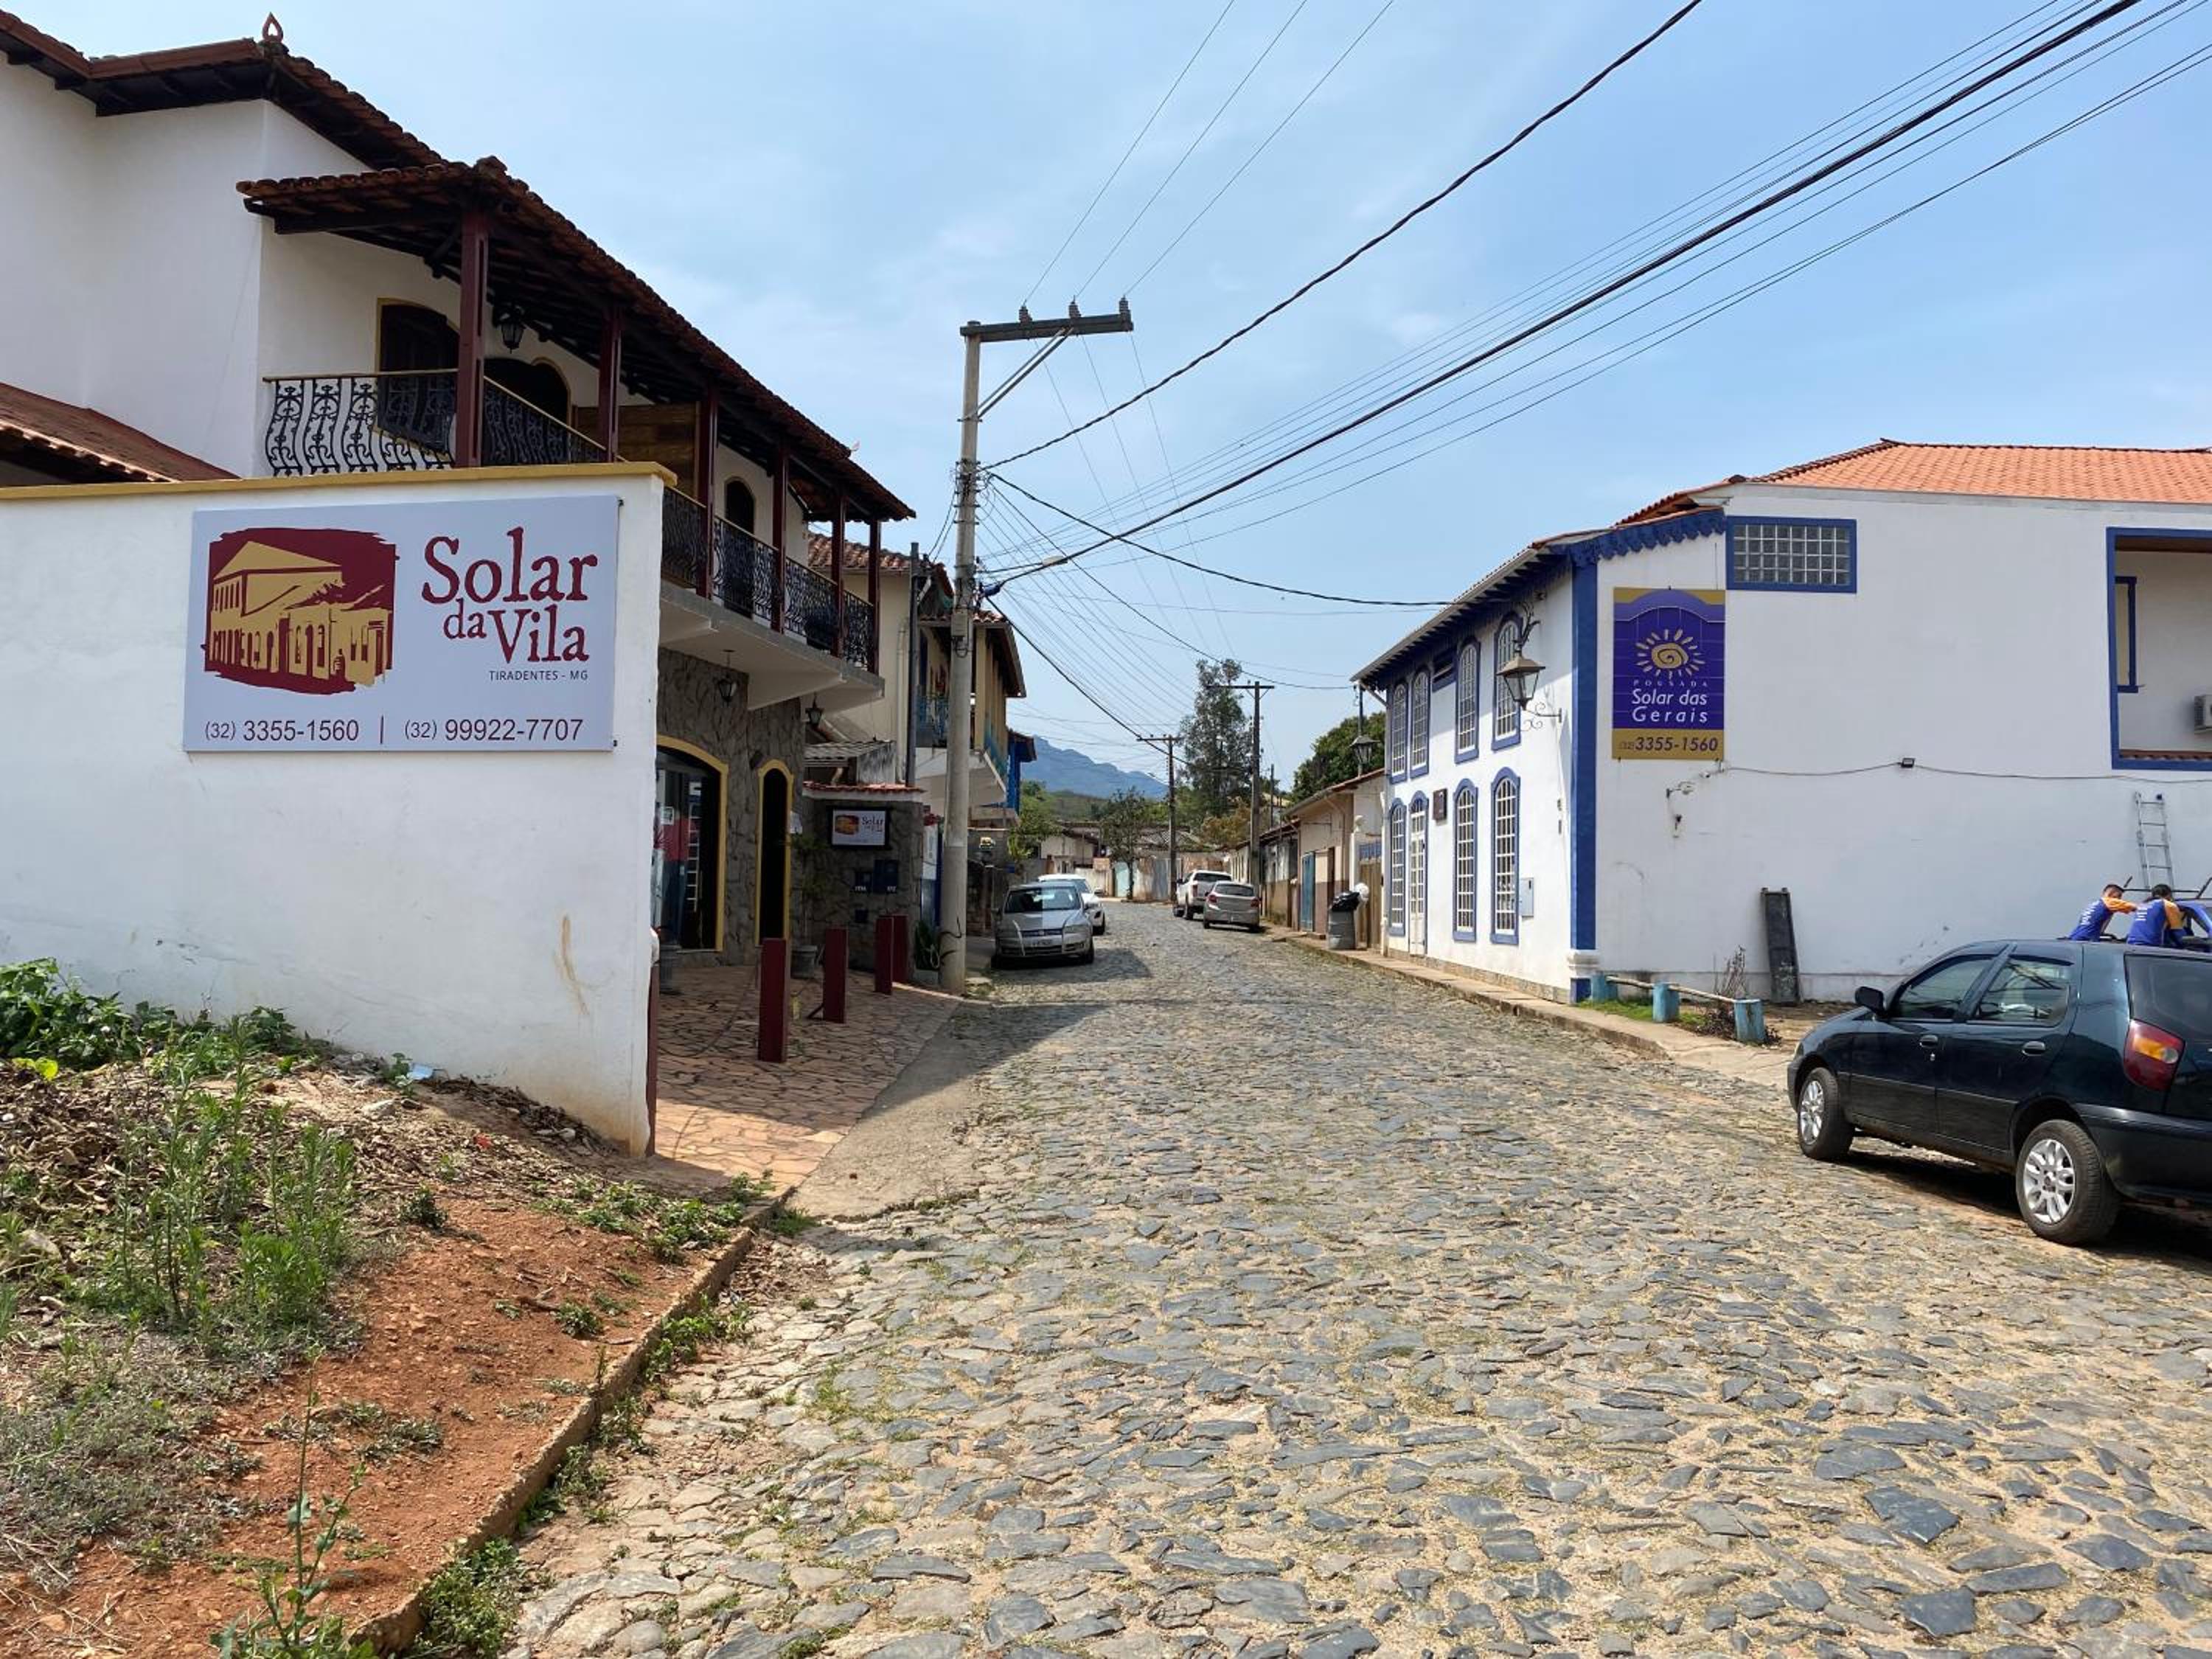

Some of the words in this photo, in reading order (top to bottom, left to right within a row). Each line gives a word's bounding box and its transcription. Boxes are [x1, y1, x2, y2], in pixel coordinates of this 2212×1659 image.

[421, 526, 599, 604] Solar
[442, 597, 487, 639] da
[487, 603, 590, 664] Vila
[489, 670, 558, 681] TIRADENTES
[570, 670, 588, 681] MG
[1632, 688, 1674, 704] Solar
[1679, 689, 1708, 706] das
[1632, 706, 1708, 723] Gerais
[204, 721, 237, 740] (32)
[243, 719, 359, 741] 3355-1560
[405, 720, 437, 740] (32)
[445, 719, 583, 741] 99922-7707
[1635, 737, 1718, 751] 3355-1560
